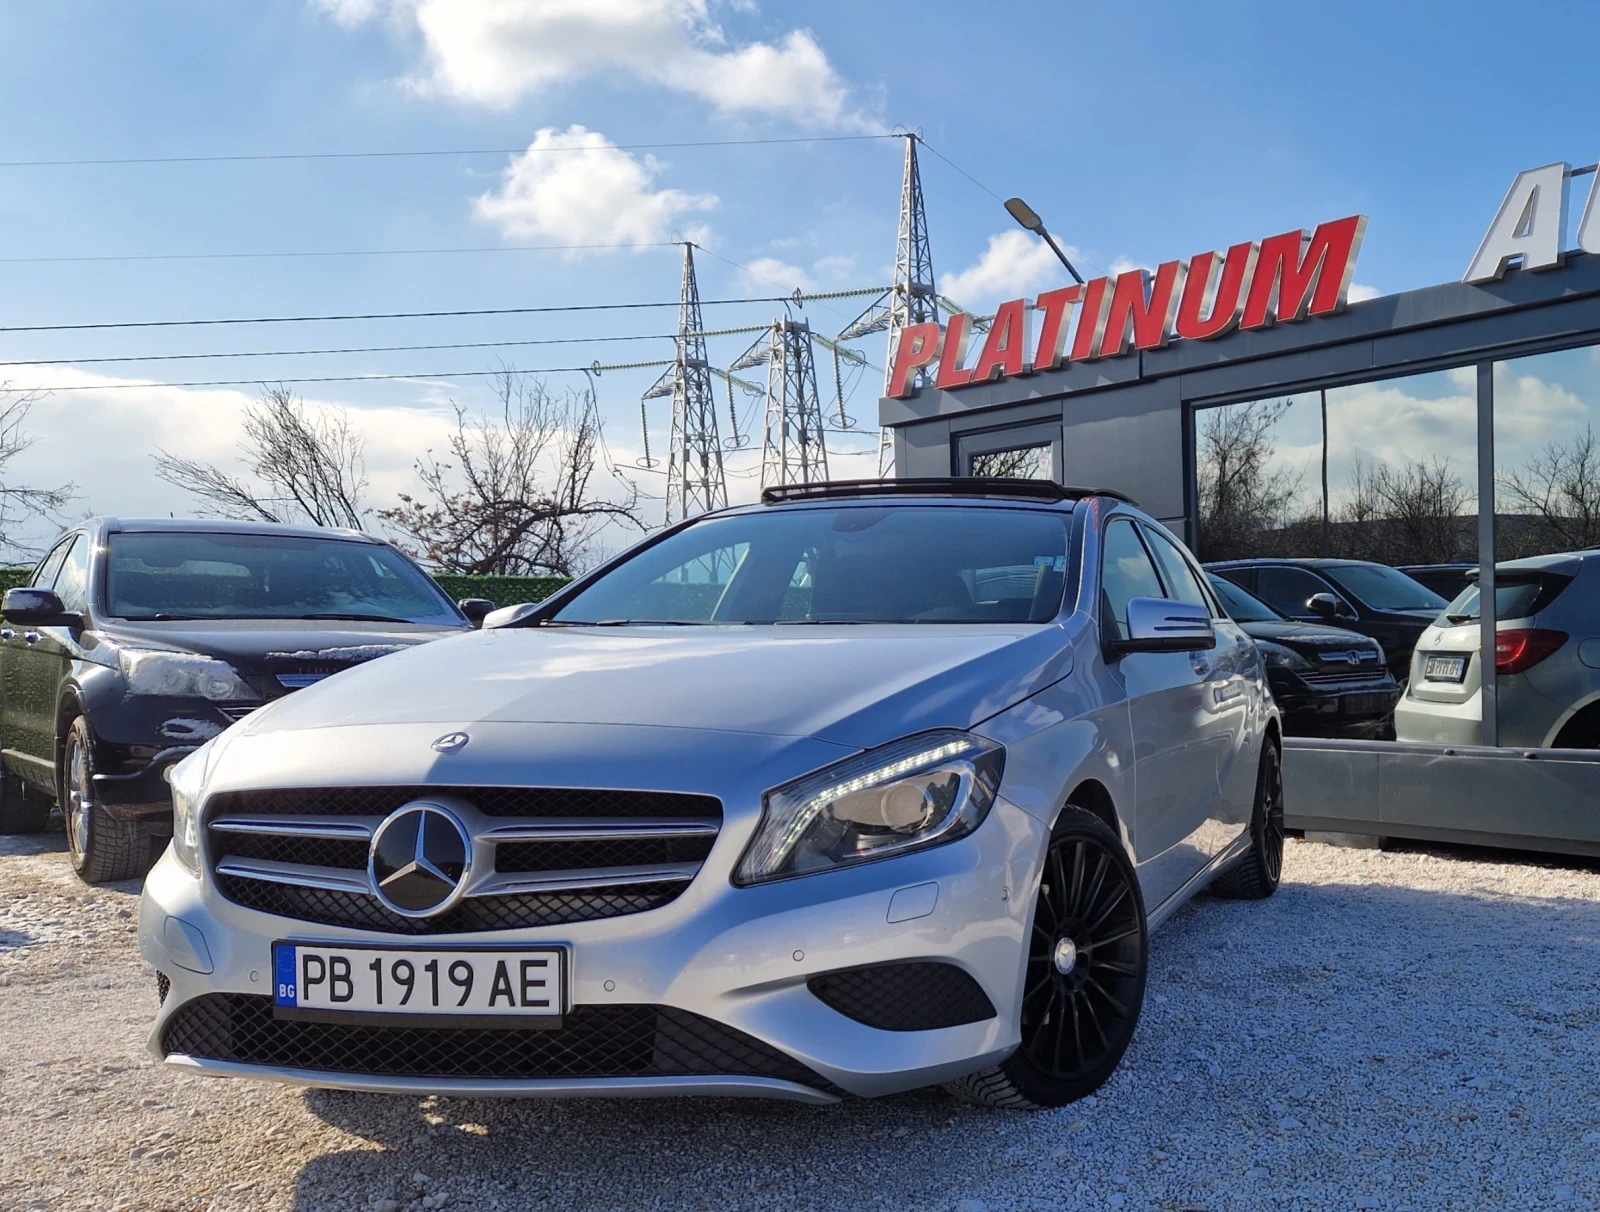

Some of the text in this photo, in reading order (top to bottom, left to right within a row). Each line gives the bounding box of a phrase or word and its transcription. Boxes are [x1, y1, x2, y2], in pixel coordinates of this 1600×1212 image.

[887, 214, 1367, 398] PLATINUM
[279, 983, 295, 998] BG
[303, 954, 550, 1007] PB 1919 AE
